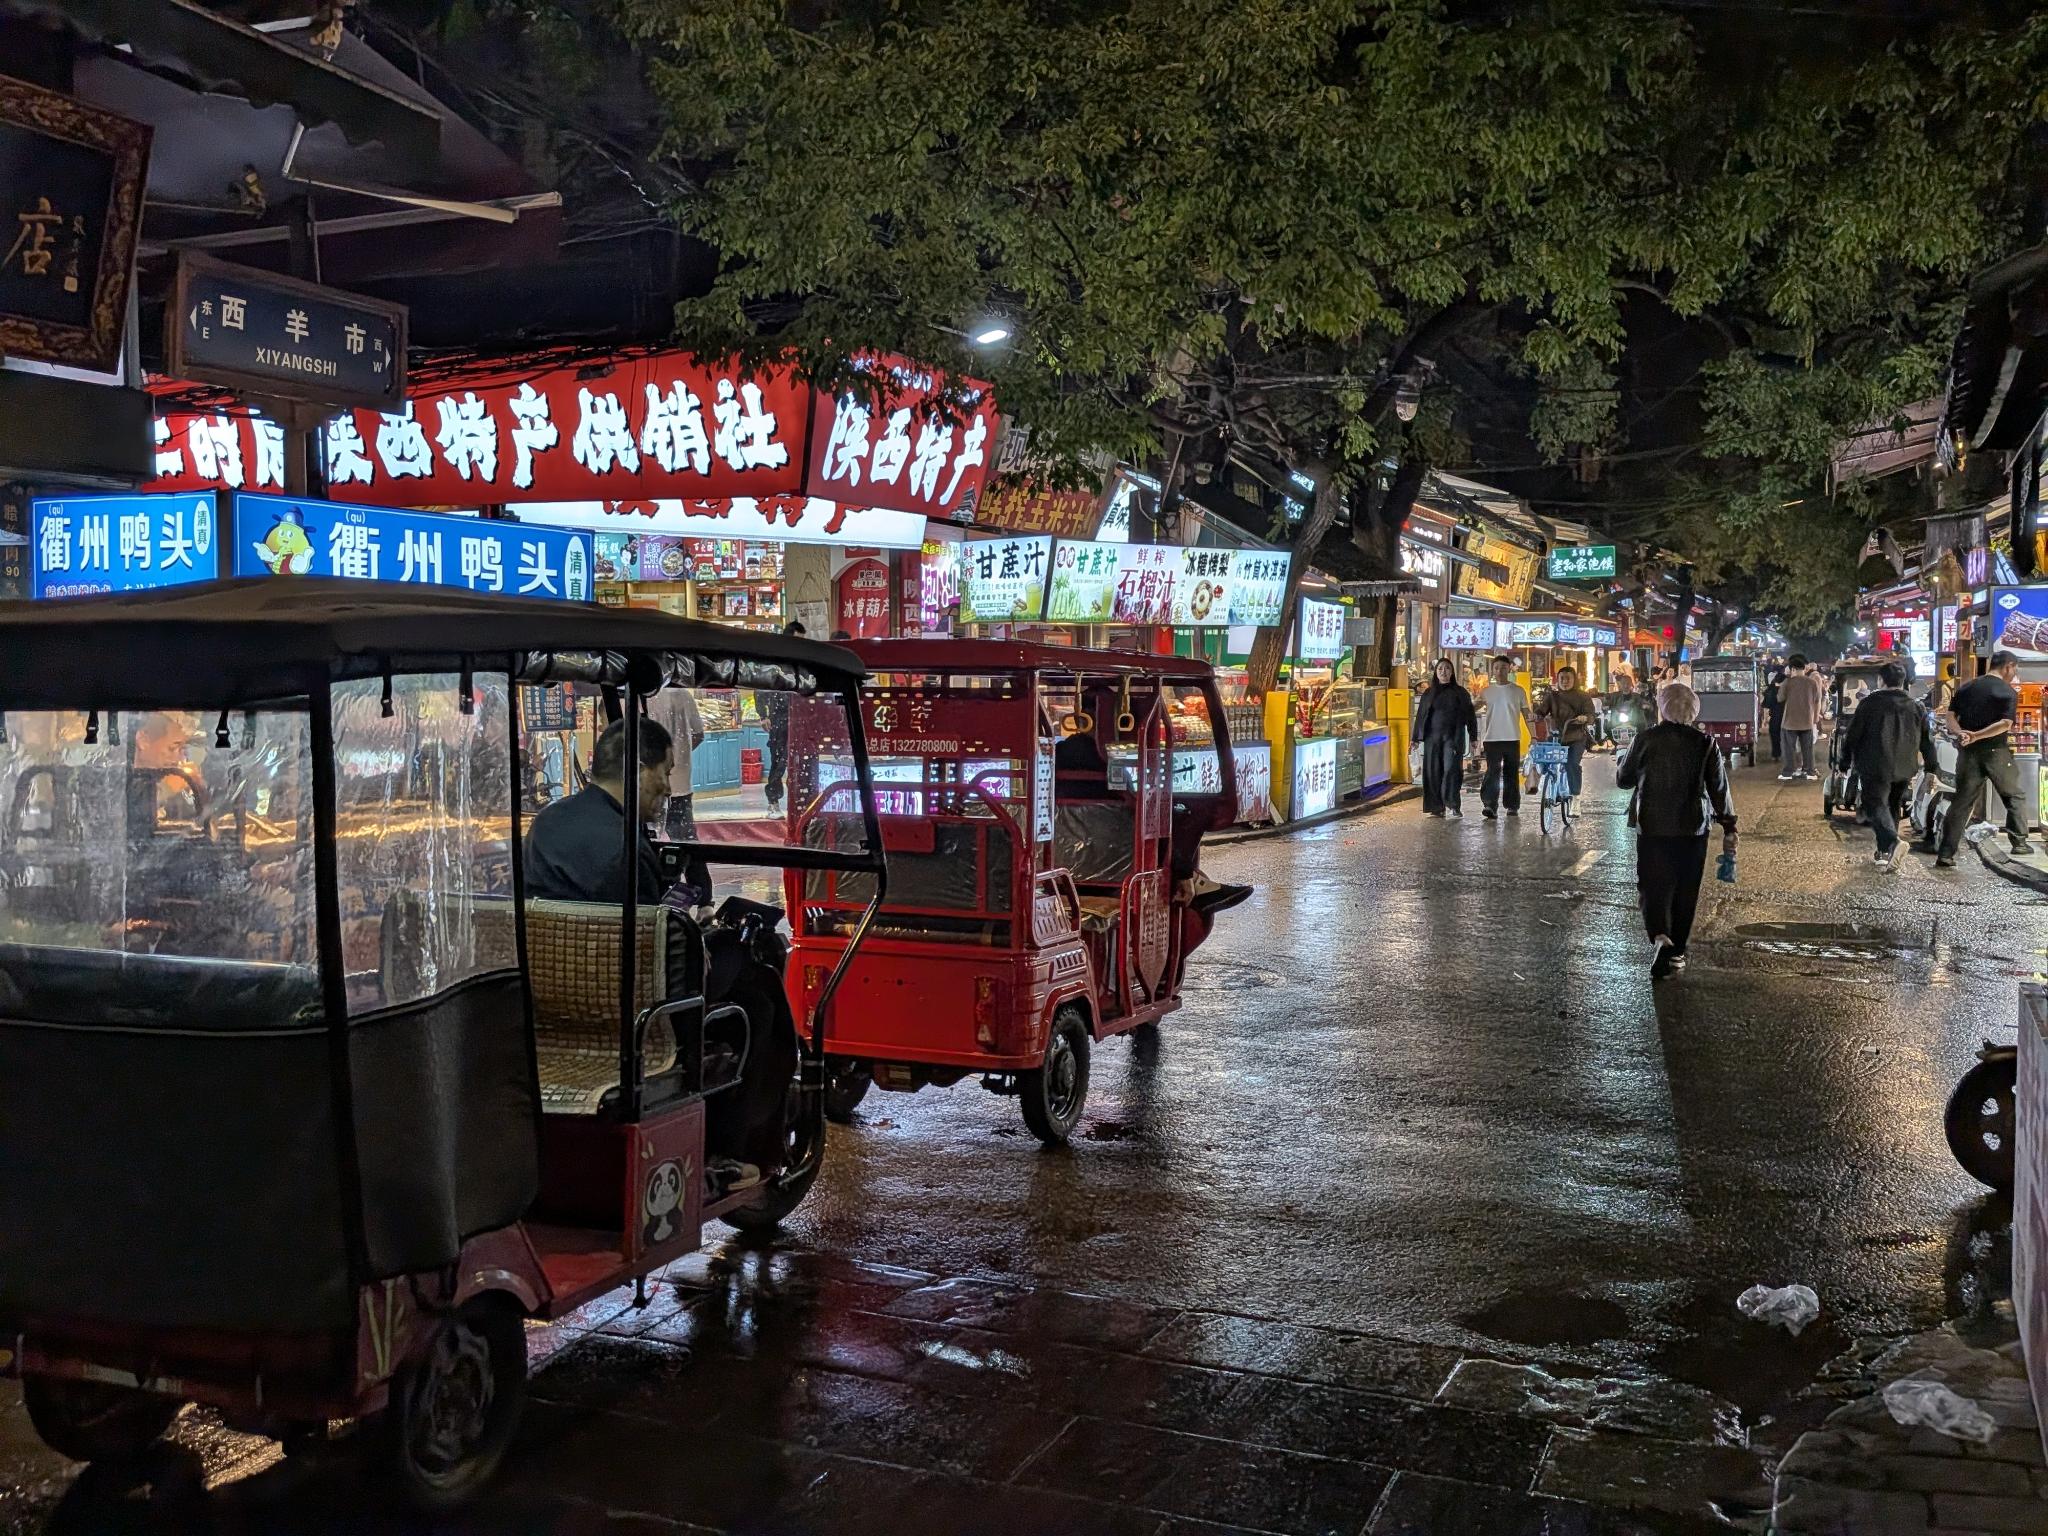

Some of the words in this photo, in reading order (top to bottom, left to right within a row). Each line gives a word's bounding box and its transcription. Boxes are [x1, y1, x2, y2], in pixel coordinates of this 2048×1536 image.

[201, 300, 213, 315] 东
[202, 326, 210, 339] E
[220, 294, 367, 355] 西羊市
[255, 346, 337, 377] XIYANGSHI
[373, 361, 383, 373] W
[823, 391, 987, 505] 陕西特产
[197, 510, 208, 545] 清真
[345, 509, 366, 524] (qu)
[40, 512, 194, 572] 衢州鸭头
[1137, 548, 1167, 566] 鲜榨
[329, 522, 559, 595] 衢州鸭头
[976, 541, 1045, 580] 甘蔗汁
[1077, 547, 1118, 577] 甘蔗汁
[1185, 552, 1231, 578] 冰糖烤梨
[569, 550, 584, 600] 清真
[1118, 569, 1176, 600] 石榴汁
[866, 737, 890, 753] 总店
[892, 739, 958, 753] 13227808000
